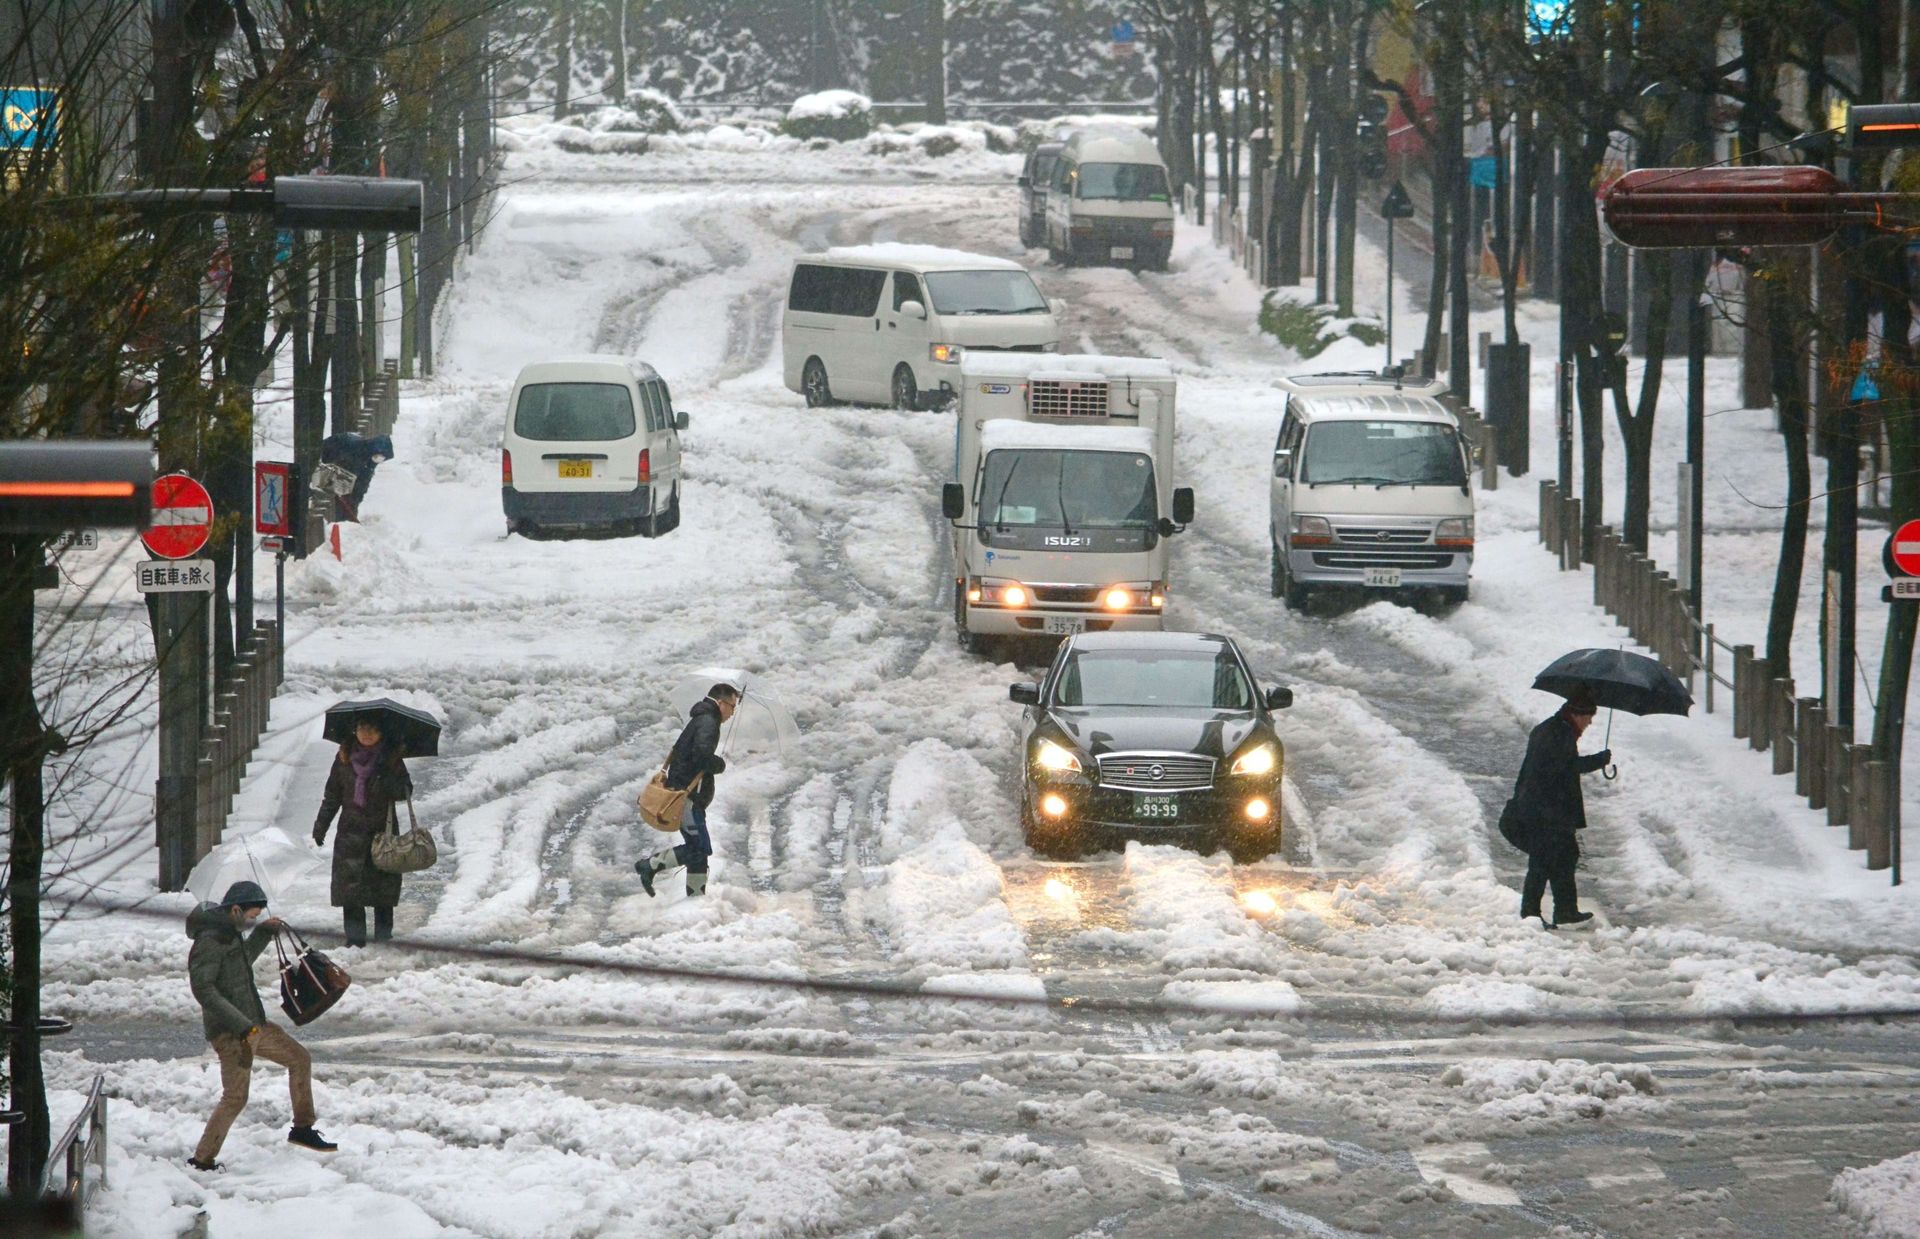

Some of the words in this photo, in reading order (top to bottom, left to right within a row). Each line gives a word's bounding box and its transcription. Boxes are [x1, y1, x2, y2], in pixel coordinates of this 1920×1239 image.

[1044, 536, 1091, 546] ISUZU
[141, 566, 211, 586] 自転車を除く
[1053, 623, 1082, 635] 35-78
[1143, 804, 1178, 817] 99-99
